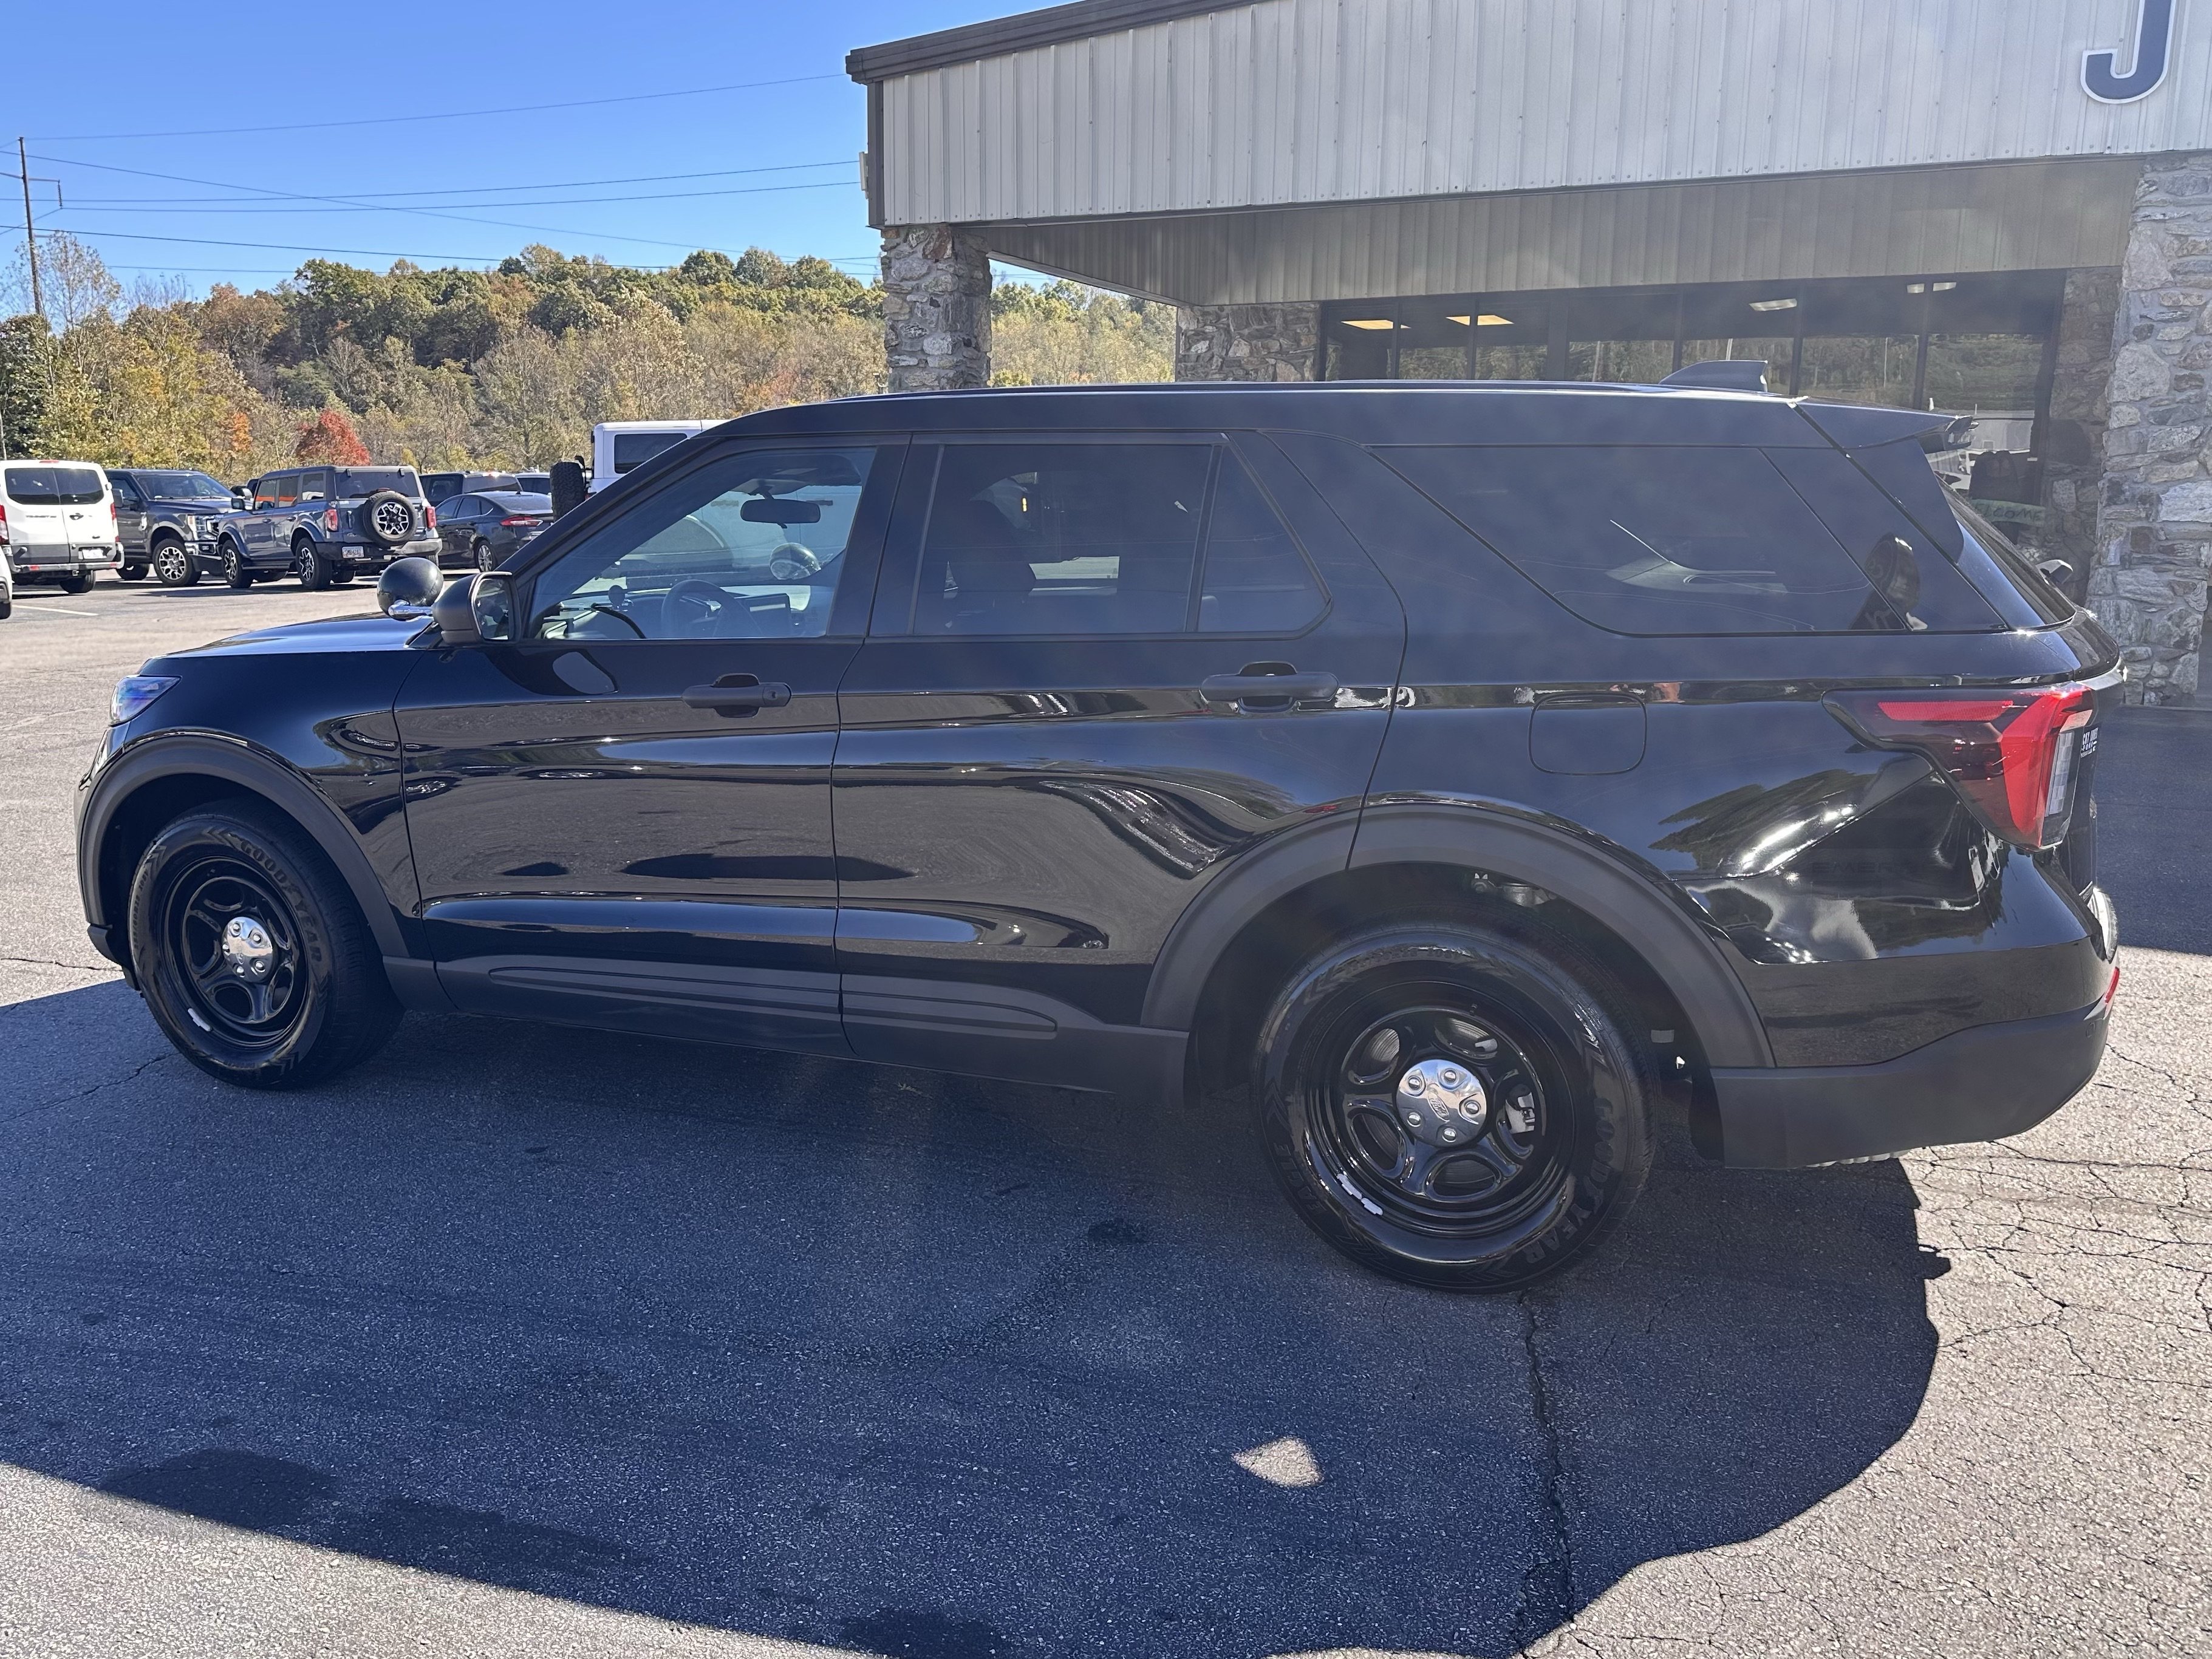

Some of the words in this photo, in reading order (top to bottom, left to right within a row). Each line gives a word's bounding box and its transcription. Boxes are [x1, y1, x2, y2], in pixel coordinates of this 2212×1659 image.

[2080, 0, 2176, 104] J
[1975, 503, 2043, 522] ELCOME
[241, 840, 323, 962] GOODYEAR
[1523, 1097, 1615, 1264] GOODYEAR
